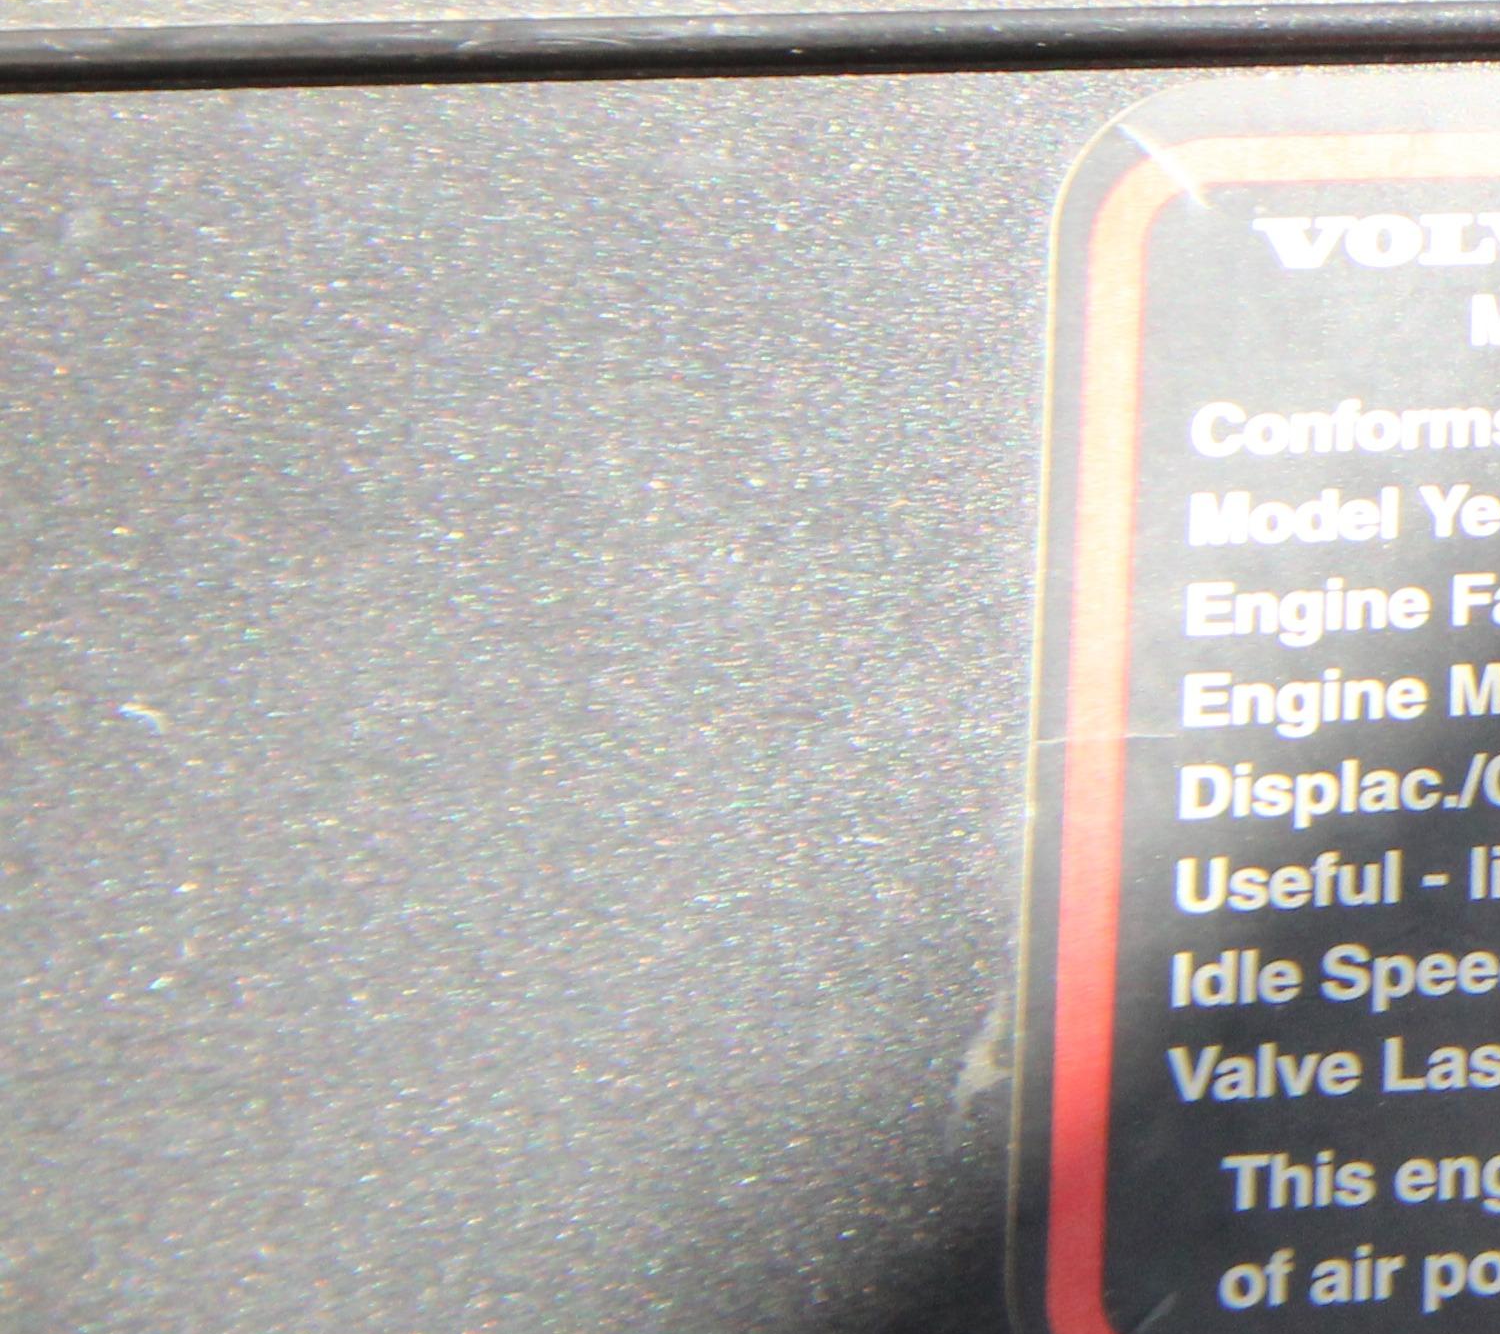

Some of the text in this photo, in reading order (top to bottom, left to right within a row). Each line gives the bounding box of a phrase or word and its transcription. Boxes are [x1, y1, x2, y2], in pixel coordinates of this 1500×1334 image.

[1188, 487, 1399, 546] Model
[1185, 578, 1429, 645] Engine
[1181, 672, 1427, 737] Engine
[1175, 847, 1400, 913] Useful
[1423, 874, 1448, 886] -
[1172, 950, 1300, 1007] Idle
[1168, 1043, 1361, 1101] Valve
[1223, 1151, 1375, 1210] This
[1220, 1249, 1293, 1308] of
[1311, 1245, 1404, 1304] air
